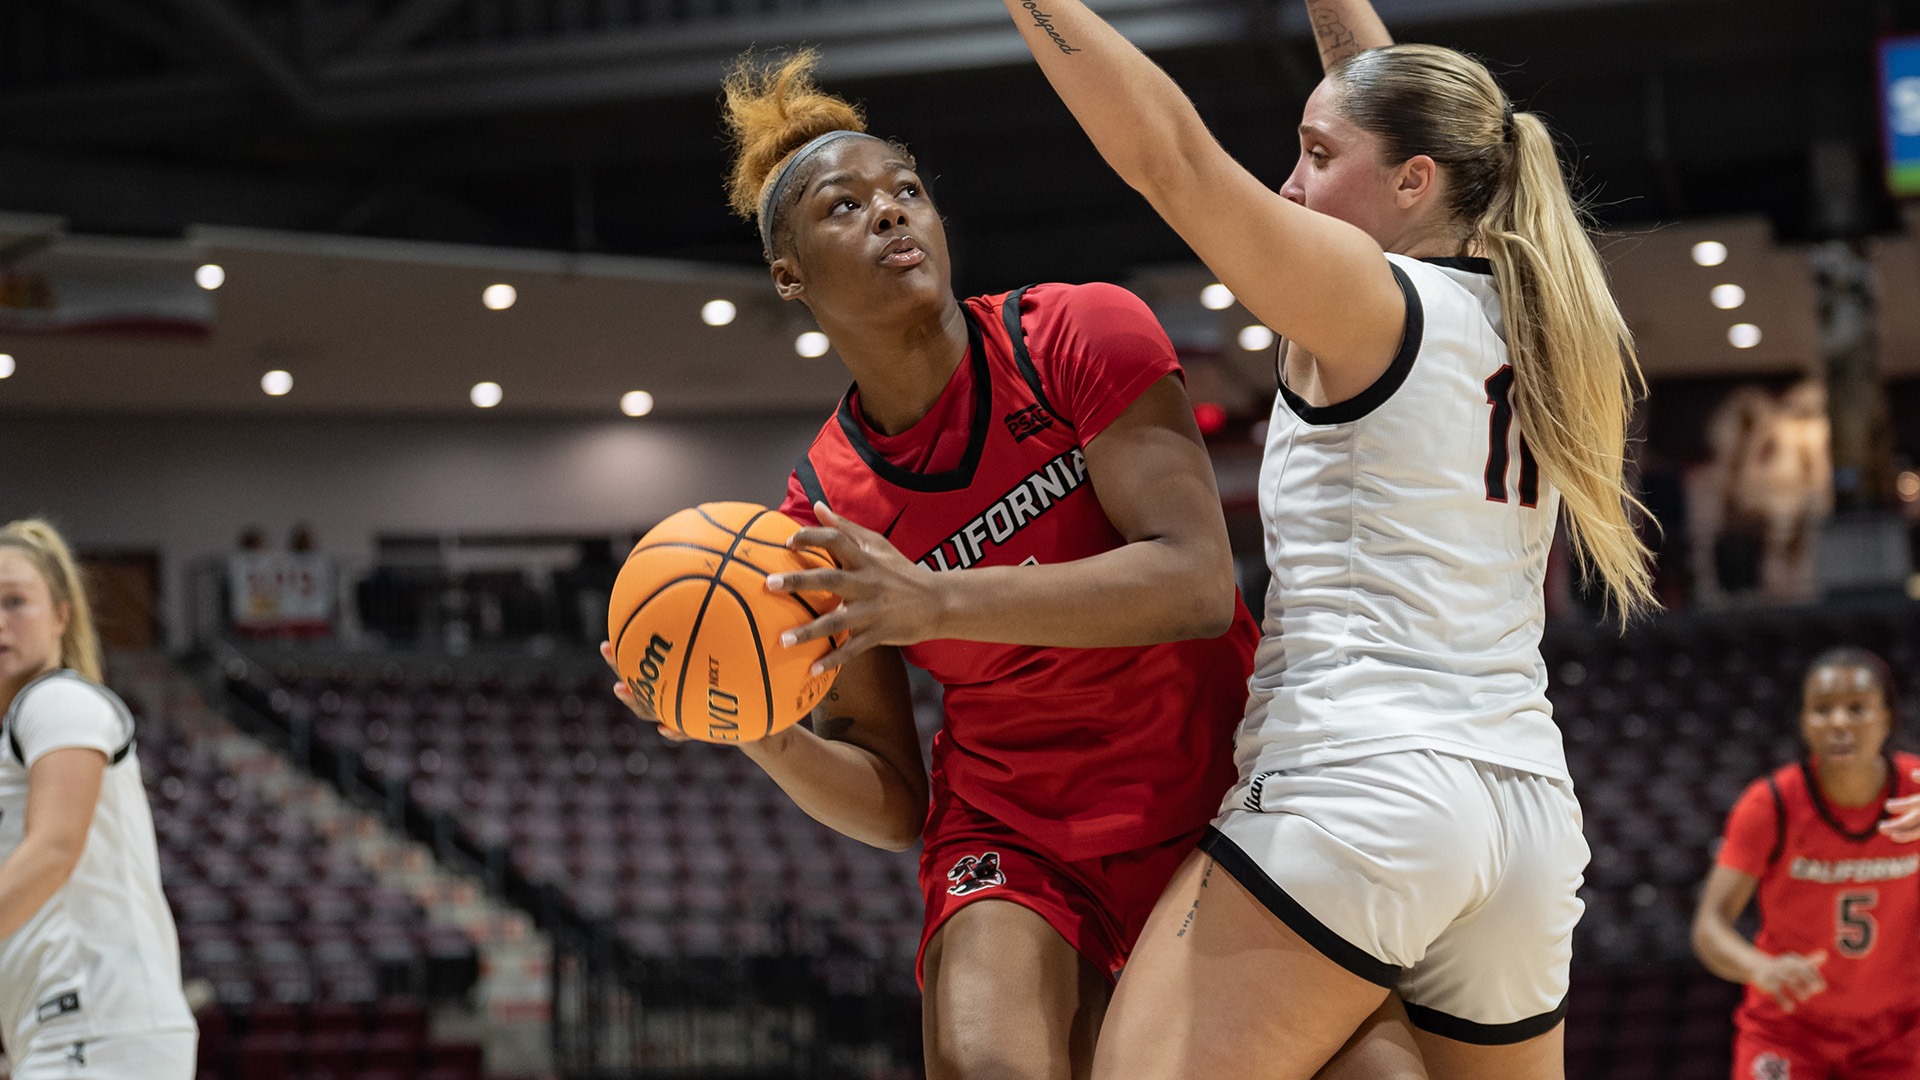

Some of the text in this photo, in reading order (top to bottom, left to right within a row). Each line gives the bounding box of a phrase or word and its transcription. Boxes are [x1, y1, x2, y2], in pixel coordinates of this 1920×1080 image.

[1020, 0, 1082, 55] odspeed
[1006, 407, 1051, 437] PSAC
[627, 633, 674, 715] lson
[1836, 888, 1879, 959] 5
